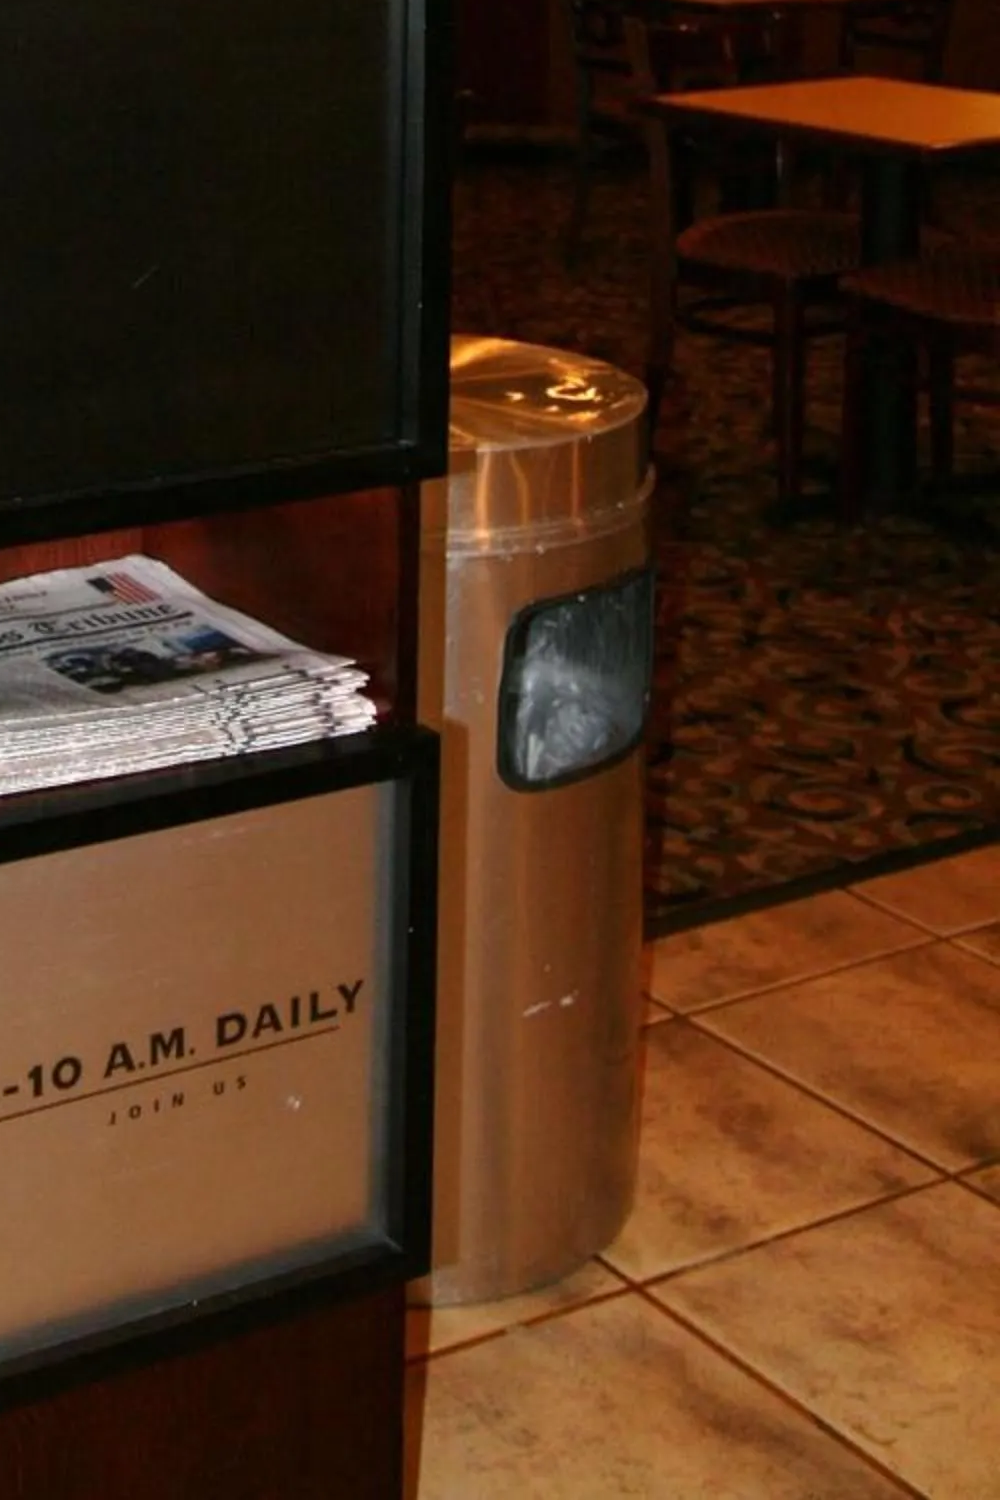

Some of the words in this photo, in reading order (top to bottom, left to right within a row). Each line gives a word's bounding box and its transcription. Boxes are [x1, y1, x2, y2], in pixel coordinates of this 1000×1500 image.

[103, 1027, 196, 1079] A.M.
[216, 979, 364, 1049] DAILY
[107, 1092, 185, 1126] JOIN
[213, 1075, 248, 1096] US
